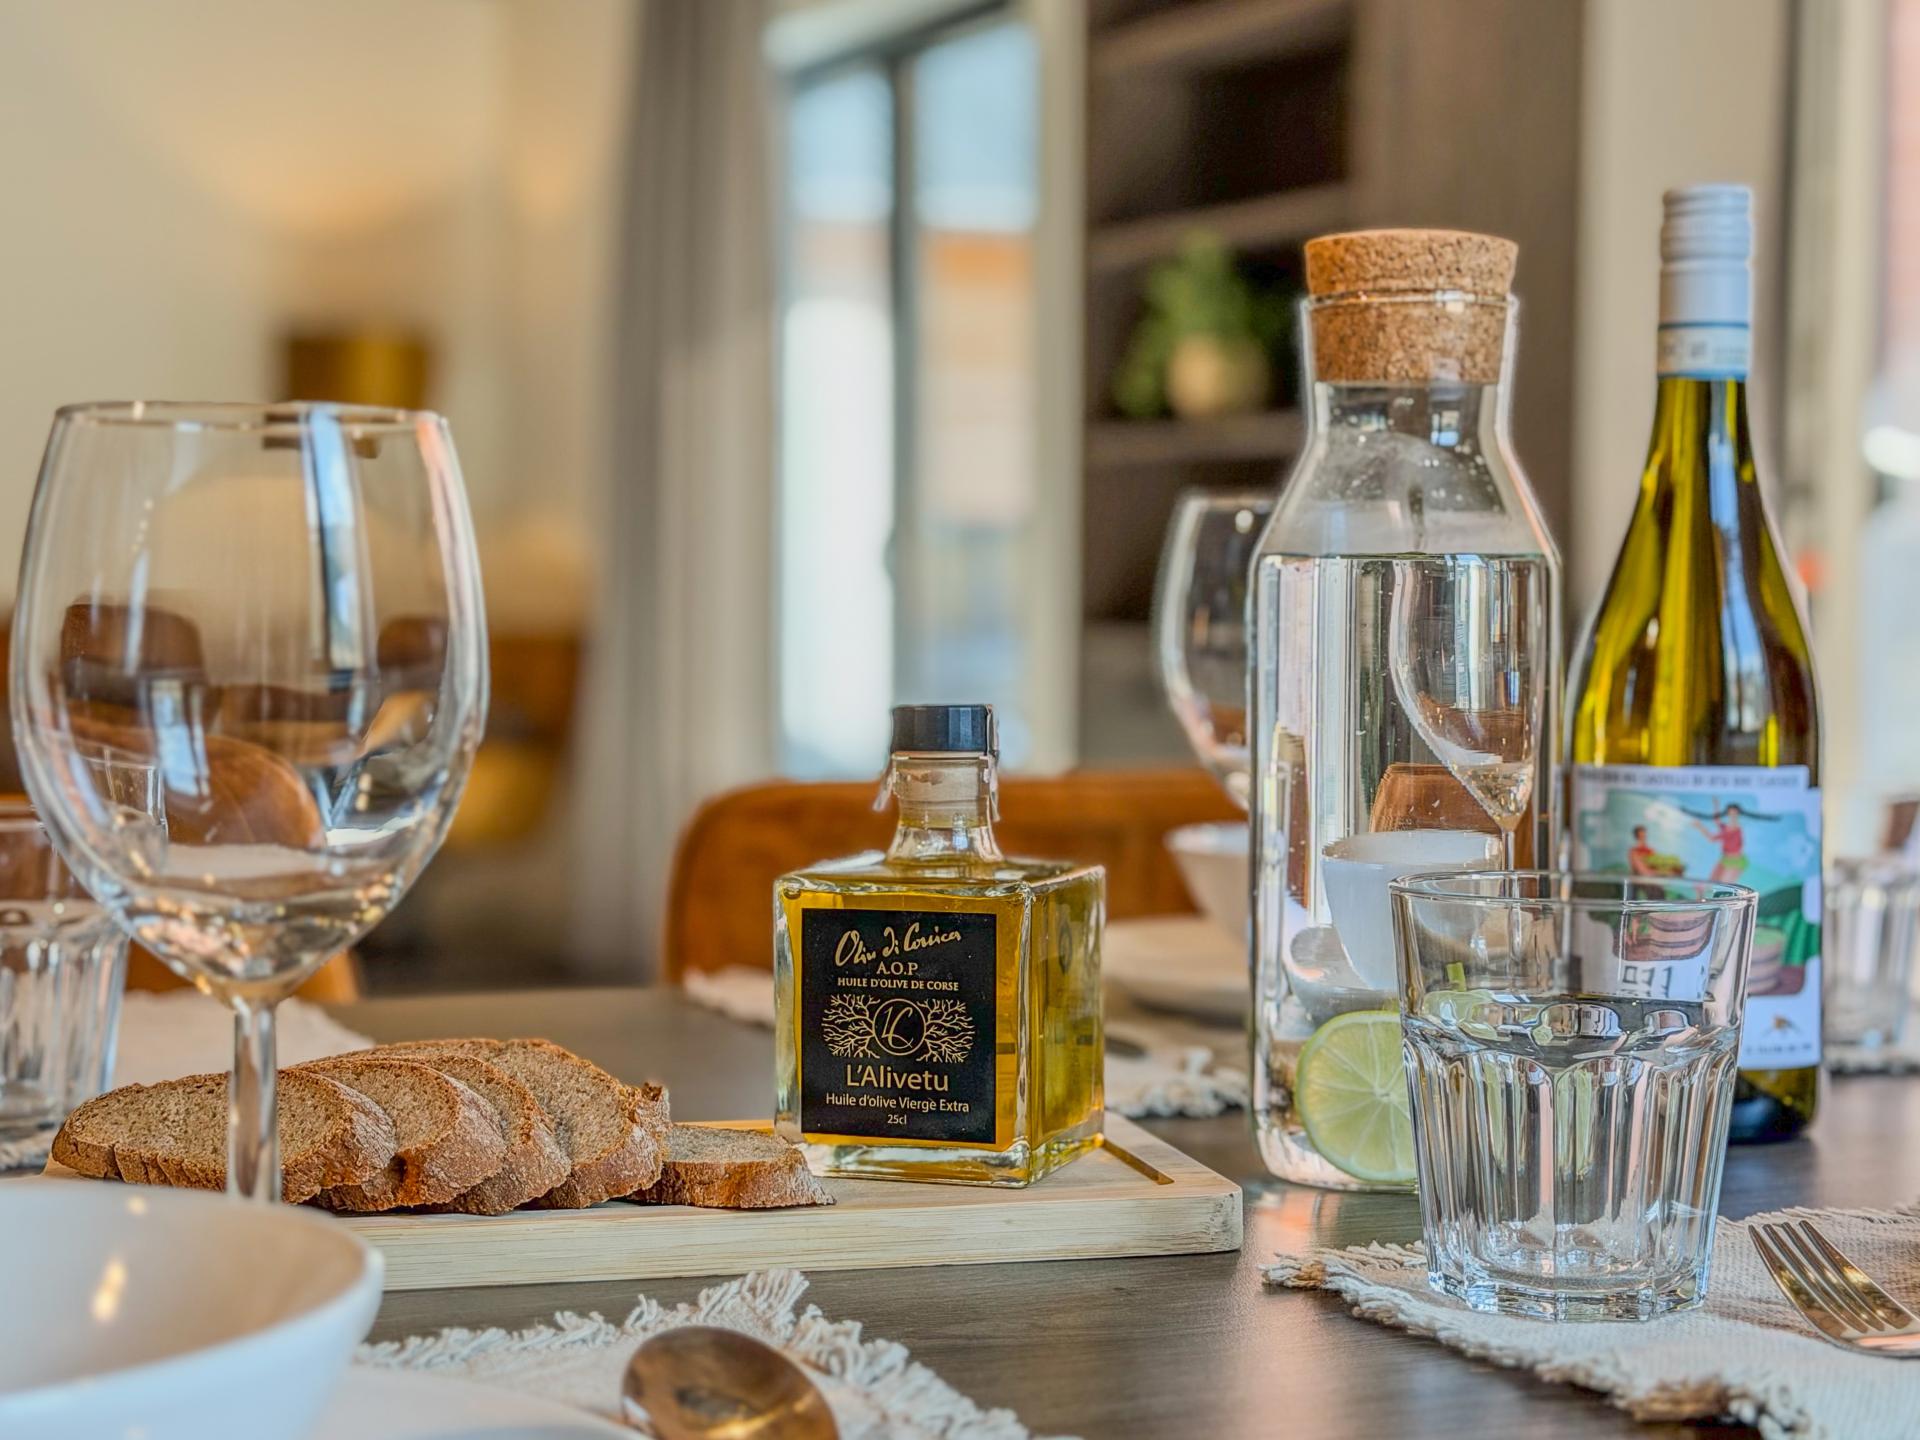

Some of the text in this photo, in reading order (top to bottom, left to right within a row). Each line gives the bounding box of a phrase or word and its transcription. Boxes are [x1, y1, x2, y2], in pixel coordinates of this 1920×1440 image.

[882, 927, 900, 957] di
[903, 922, 962, 952] Corsica
[876, 961, 918, 976] A.O.P
[837, 977, 960, 991] HUILE D'OLIVE DE CORSE
[846, 1064, 949, 1092] L'Alivetu
[826, 1093, 857, 1106] Huile
[859, 1094, 896, 1109] d'olive
[939, 1099, 970, 1112] Extra
[888, 1114, 907, 1126] 25cl
